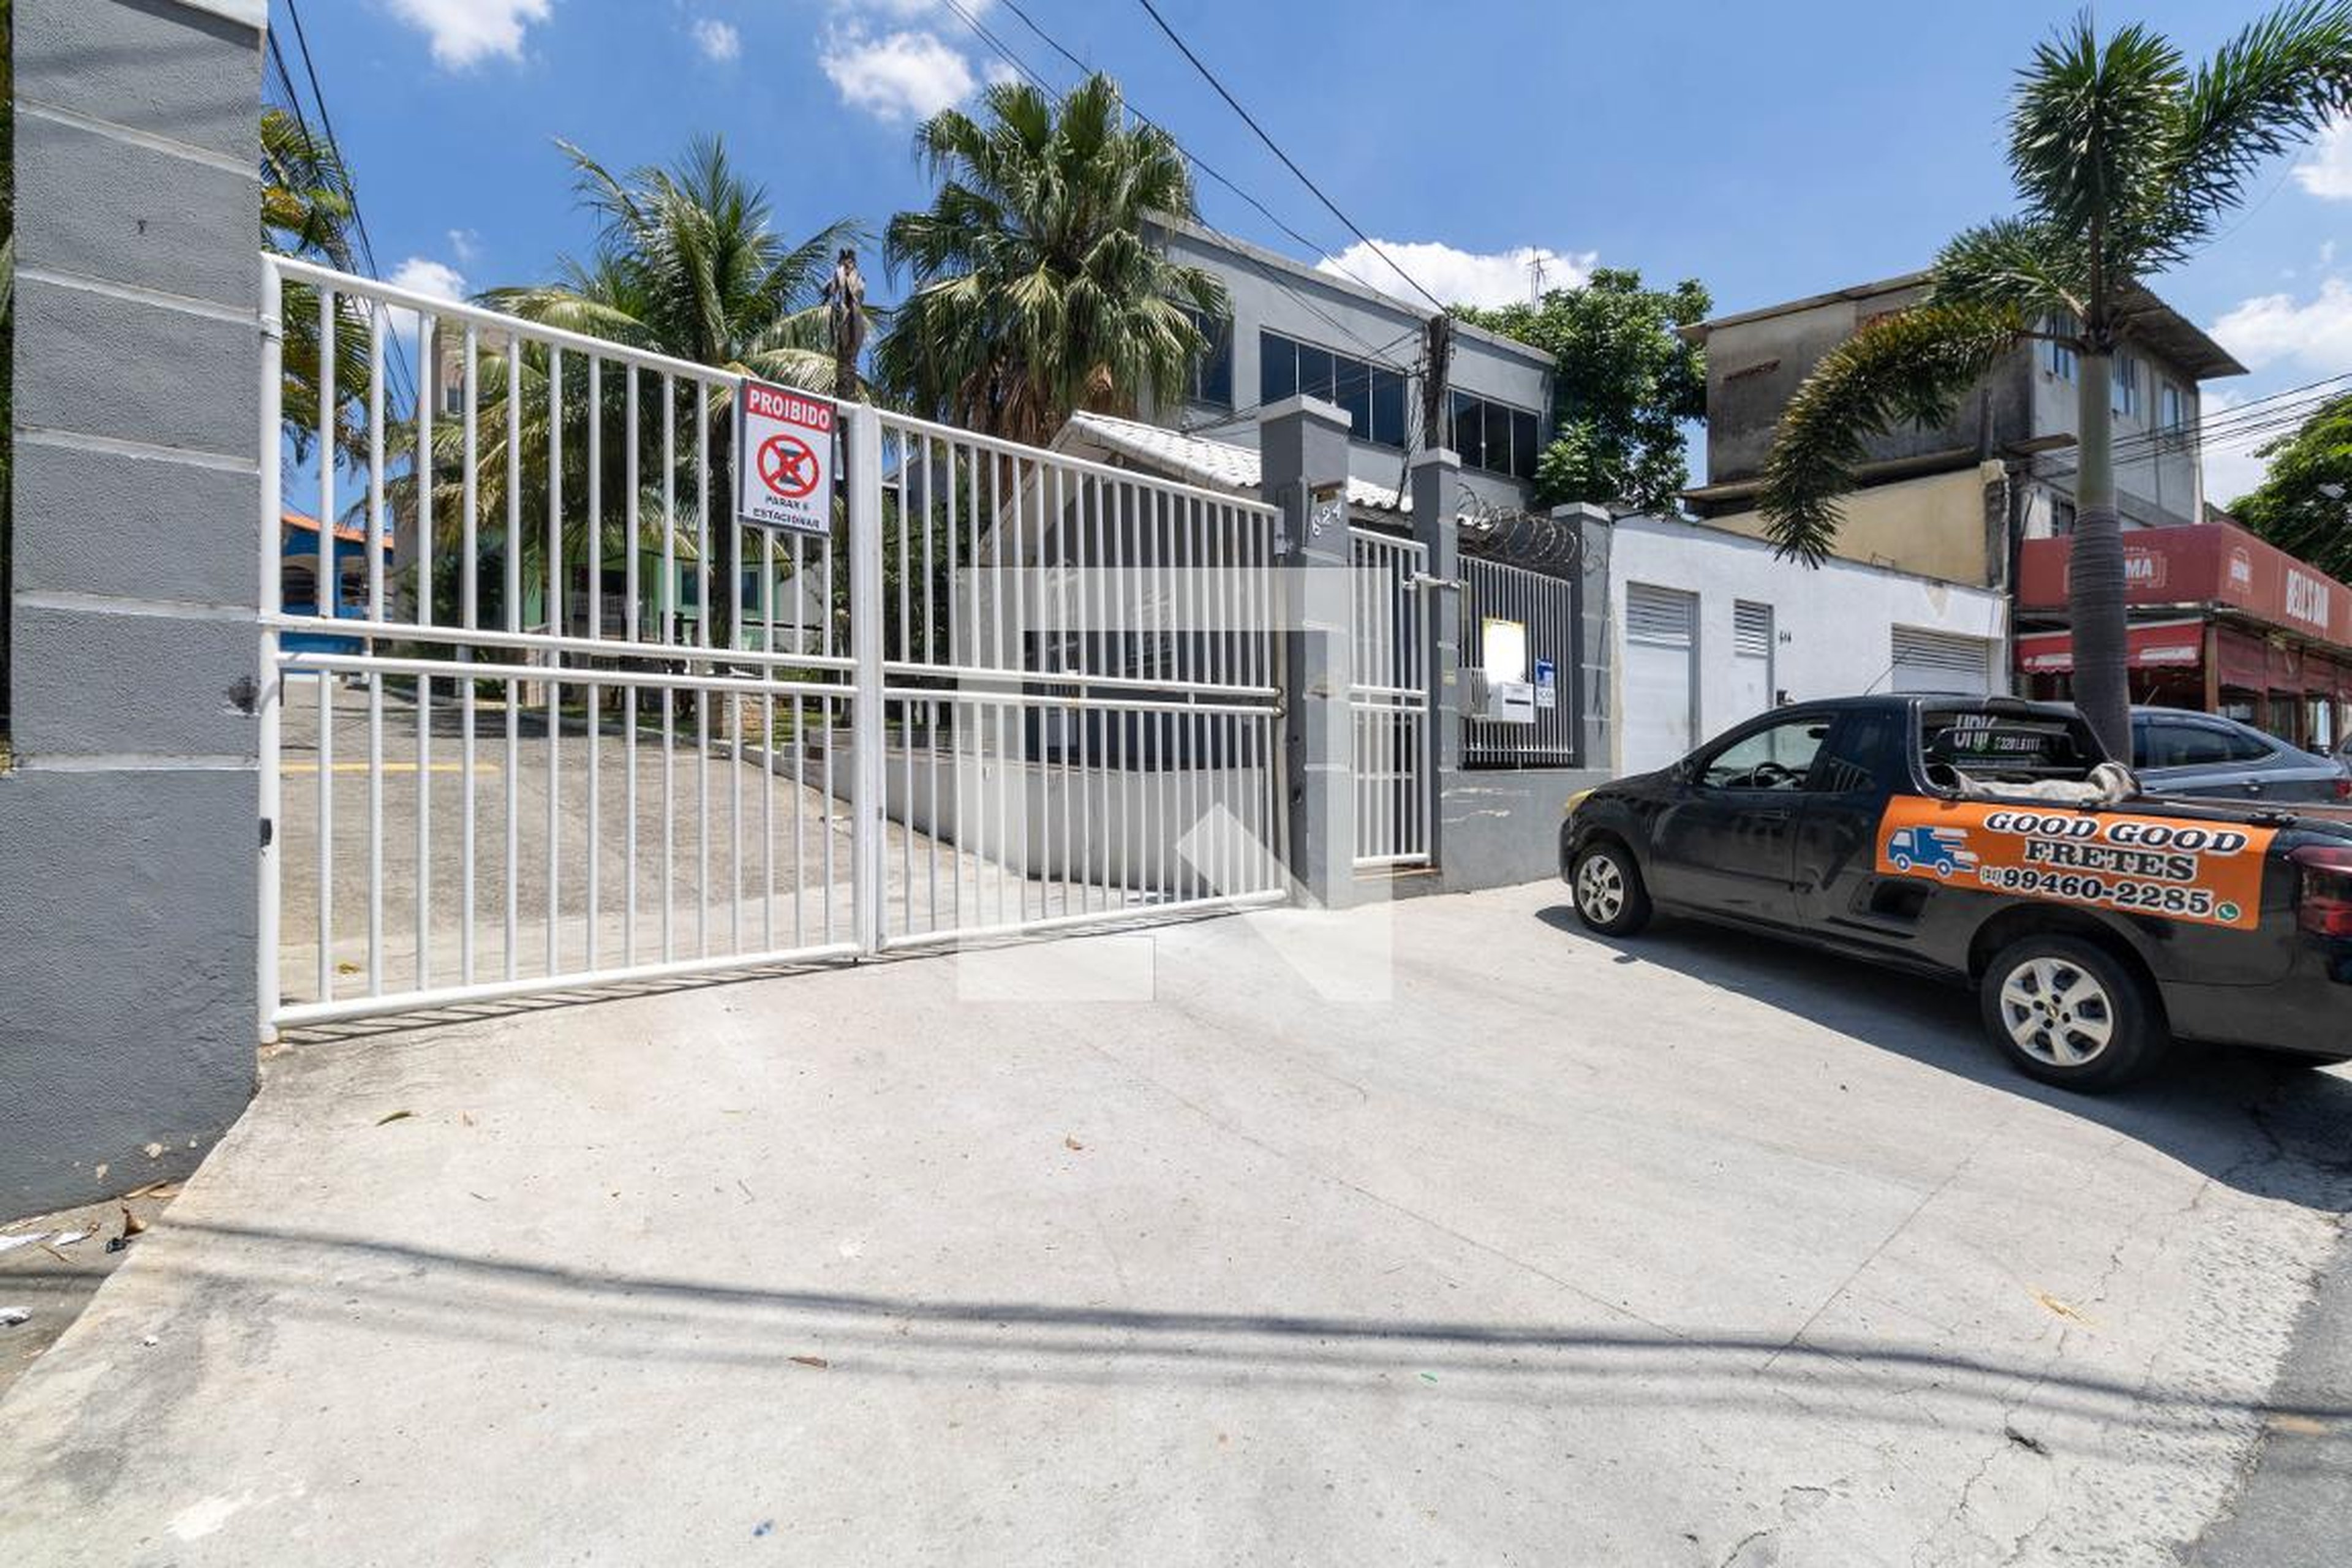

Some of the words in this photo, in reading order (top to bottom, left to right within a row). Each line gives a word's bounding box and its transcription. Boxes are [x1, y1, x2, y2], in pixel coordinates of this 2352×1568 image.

[749, 388, 830, 429] PROIBIDO
[753, 508, 820, 529] ESTACIONAR
[1311, 502, 1342, 536] 624
[1985, 812, 2098, 838] GOOD
[2109, 823, 2248, 853] GOOD
[2024, 838, 2196, 881] FRETES
